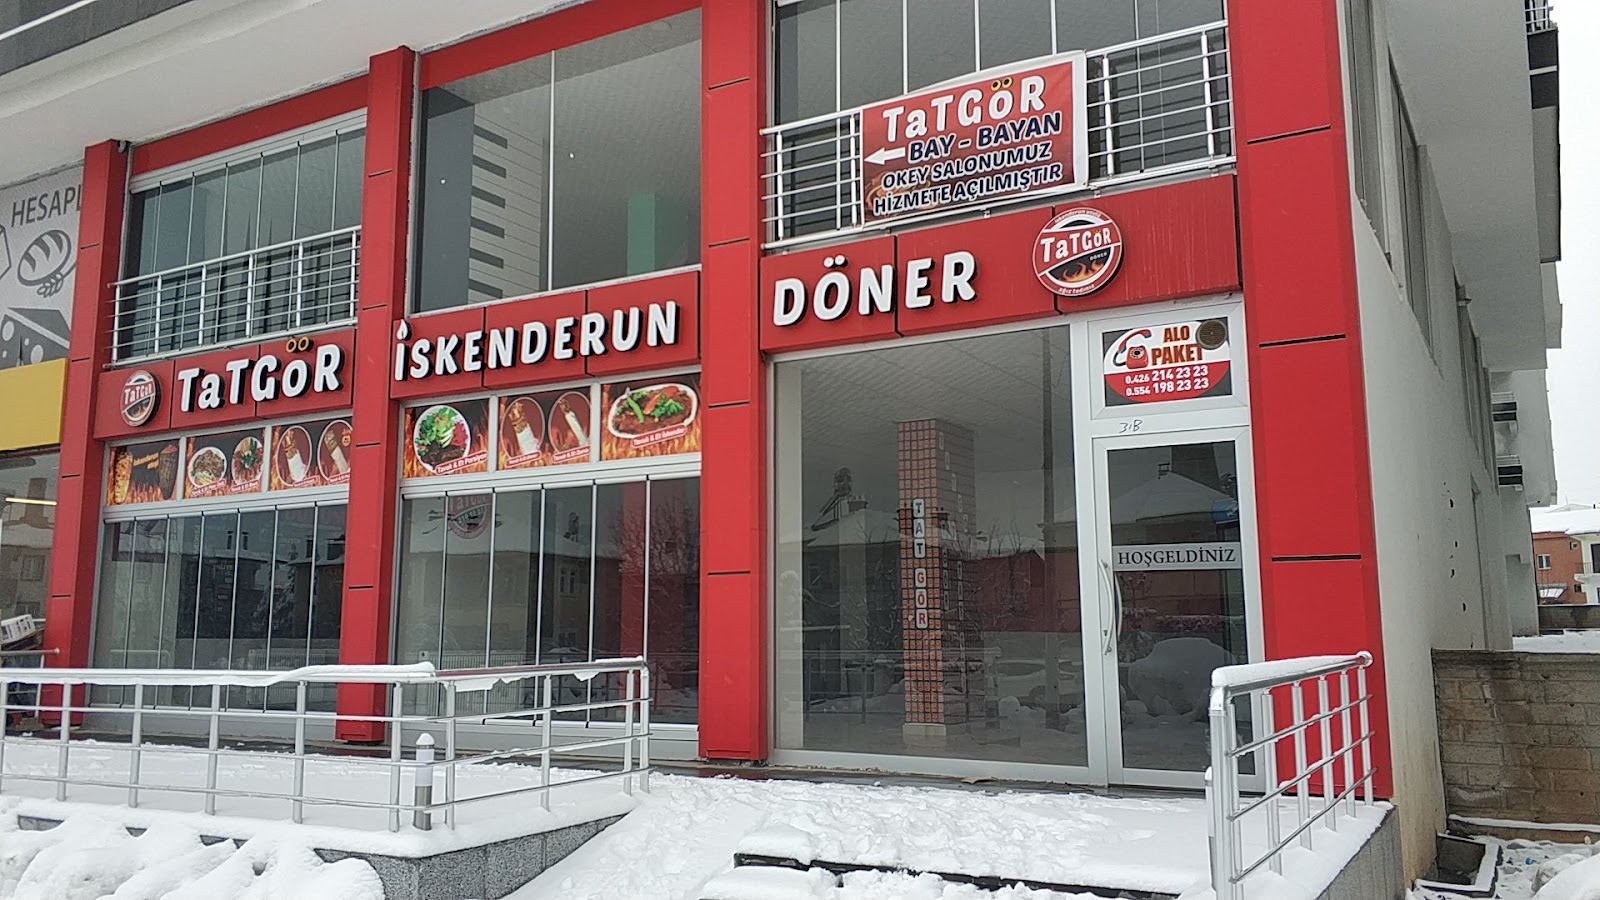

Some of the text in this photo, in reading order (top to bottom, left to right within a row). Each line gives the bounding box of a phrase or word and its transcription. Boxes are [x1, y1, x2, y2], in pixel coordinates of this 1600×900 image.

[909, 134, 955, 162] BAY
[978, 112, 1061, 148] BAYAN
[883, 142, 1051, 190] OKEY SALONUMUZ
[874, 164, 1062, 214] HİZMETE AÇILMIŞTIR
[773, 250, 977, 327] DÖNER
[394, 300, 677, 381] İSKENDERUN
[1163, 325, 1190, 343] ALO
[1151, 343, 1203, 366] PAKET
[1125, 365, 1209, 384] 0.426 214 23 23
[1126, 378, 1209, 397] 0.554 198 23 23
[1118, 548, 1236, 567] HOŞGELDİNİZ
